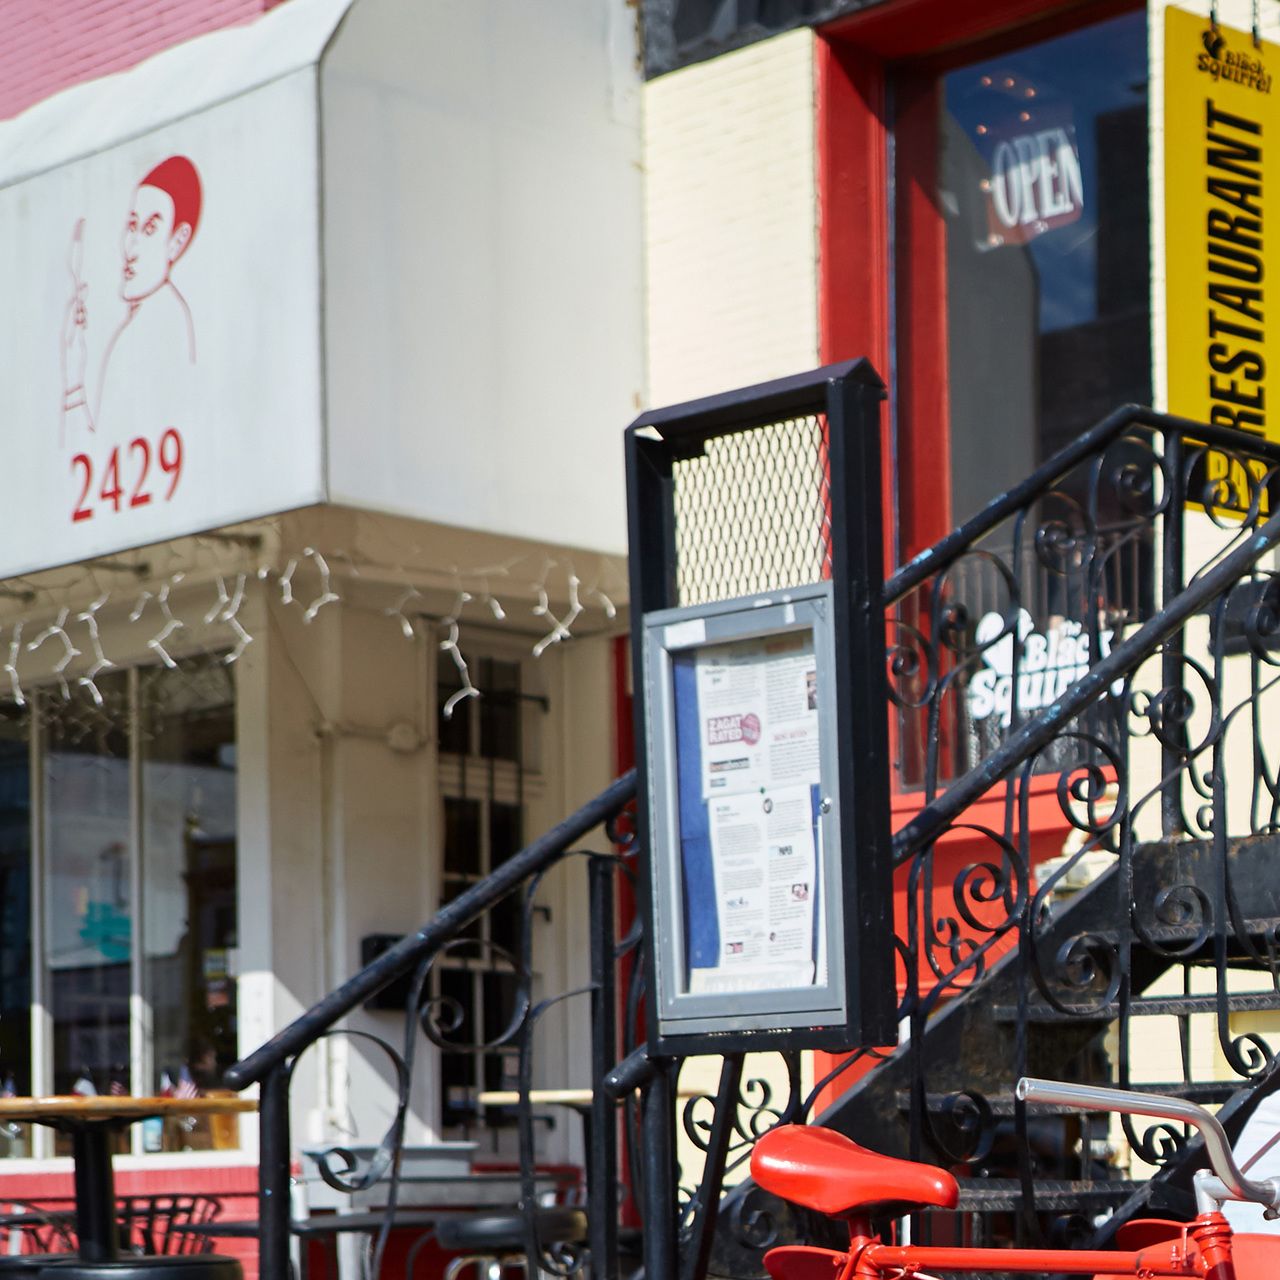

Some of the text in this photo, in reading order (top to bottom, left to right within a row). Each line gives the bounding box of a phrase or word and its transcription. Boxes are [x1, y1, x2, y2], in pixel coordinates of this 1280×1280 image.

[1197, 53, 1272, 94] Squirrel
[1224, 50, 1265, 78] Black
[992, 127, 1084, 228] OPEN
[1206, 98, 1267, 441] RESTAURANT
[70, 427, 184, 524] 2429
[709, 715, 742, 731] ZAGAT
[709, 727, 743, 743] RATED
